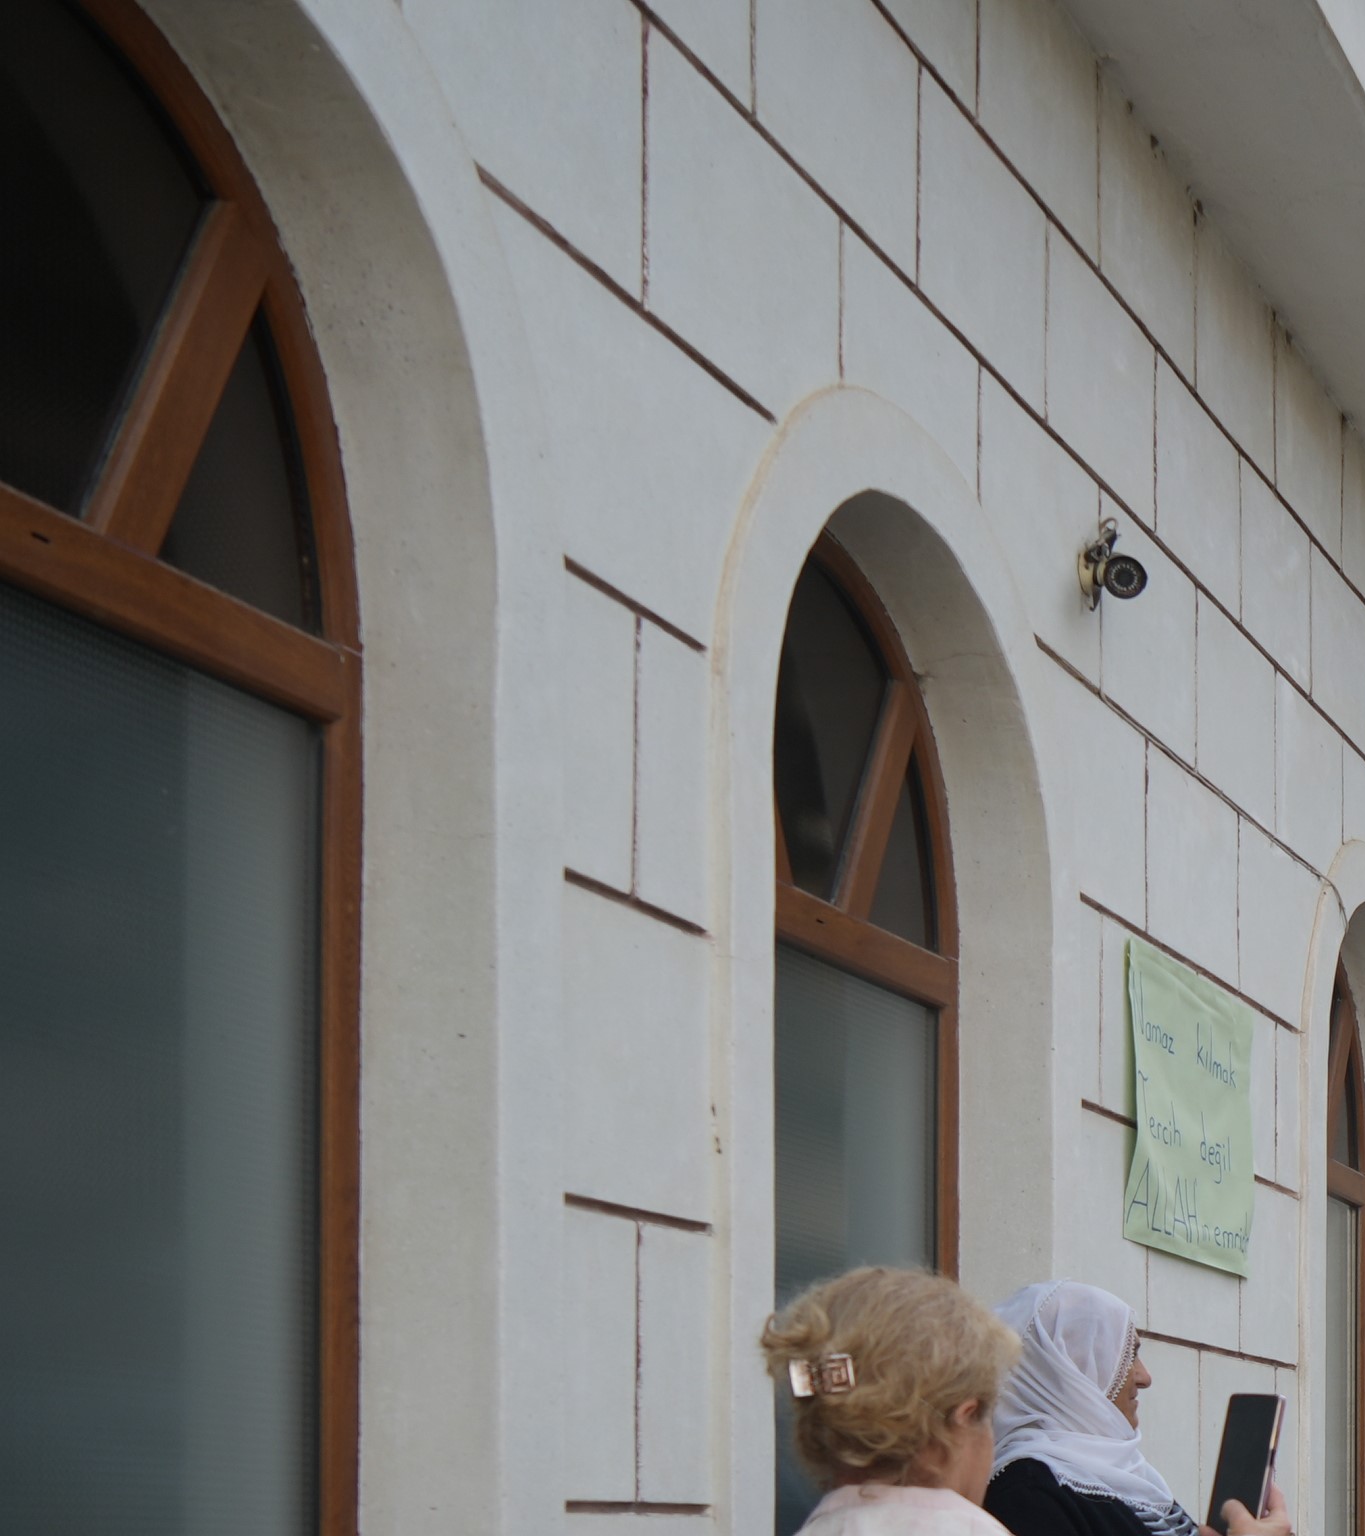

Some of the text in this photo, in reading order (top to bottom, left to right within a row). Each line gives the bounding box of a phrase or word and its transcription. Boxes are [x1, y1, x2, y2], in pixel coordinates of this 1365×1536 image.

[1131, 970, 1175, 1055] Namaz
[1138, 1070, 1232, 1185] Tercih değil
